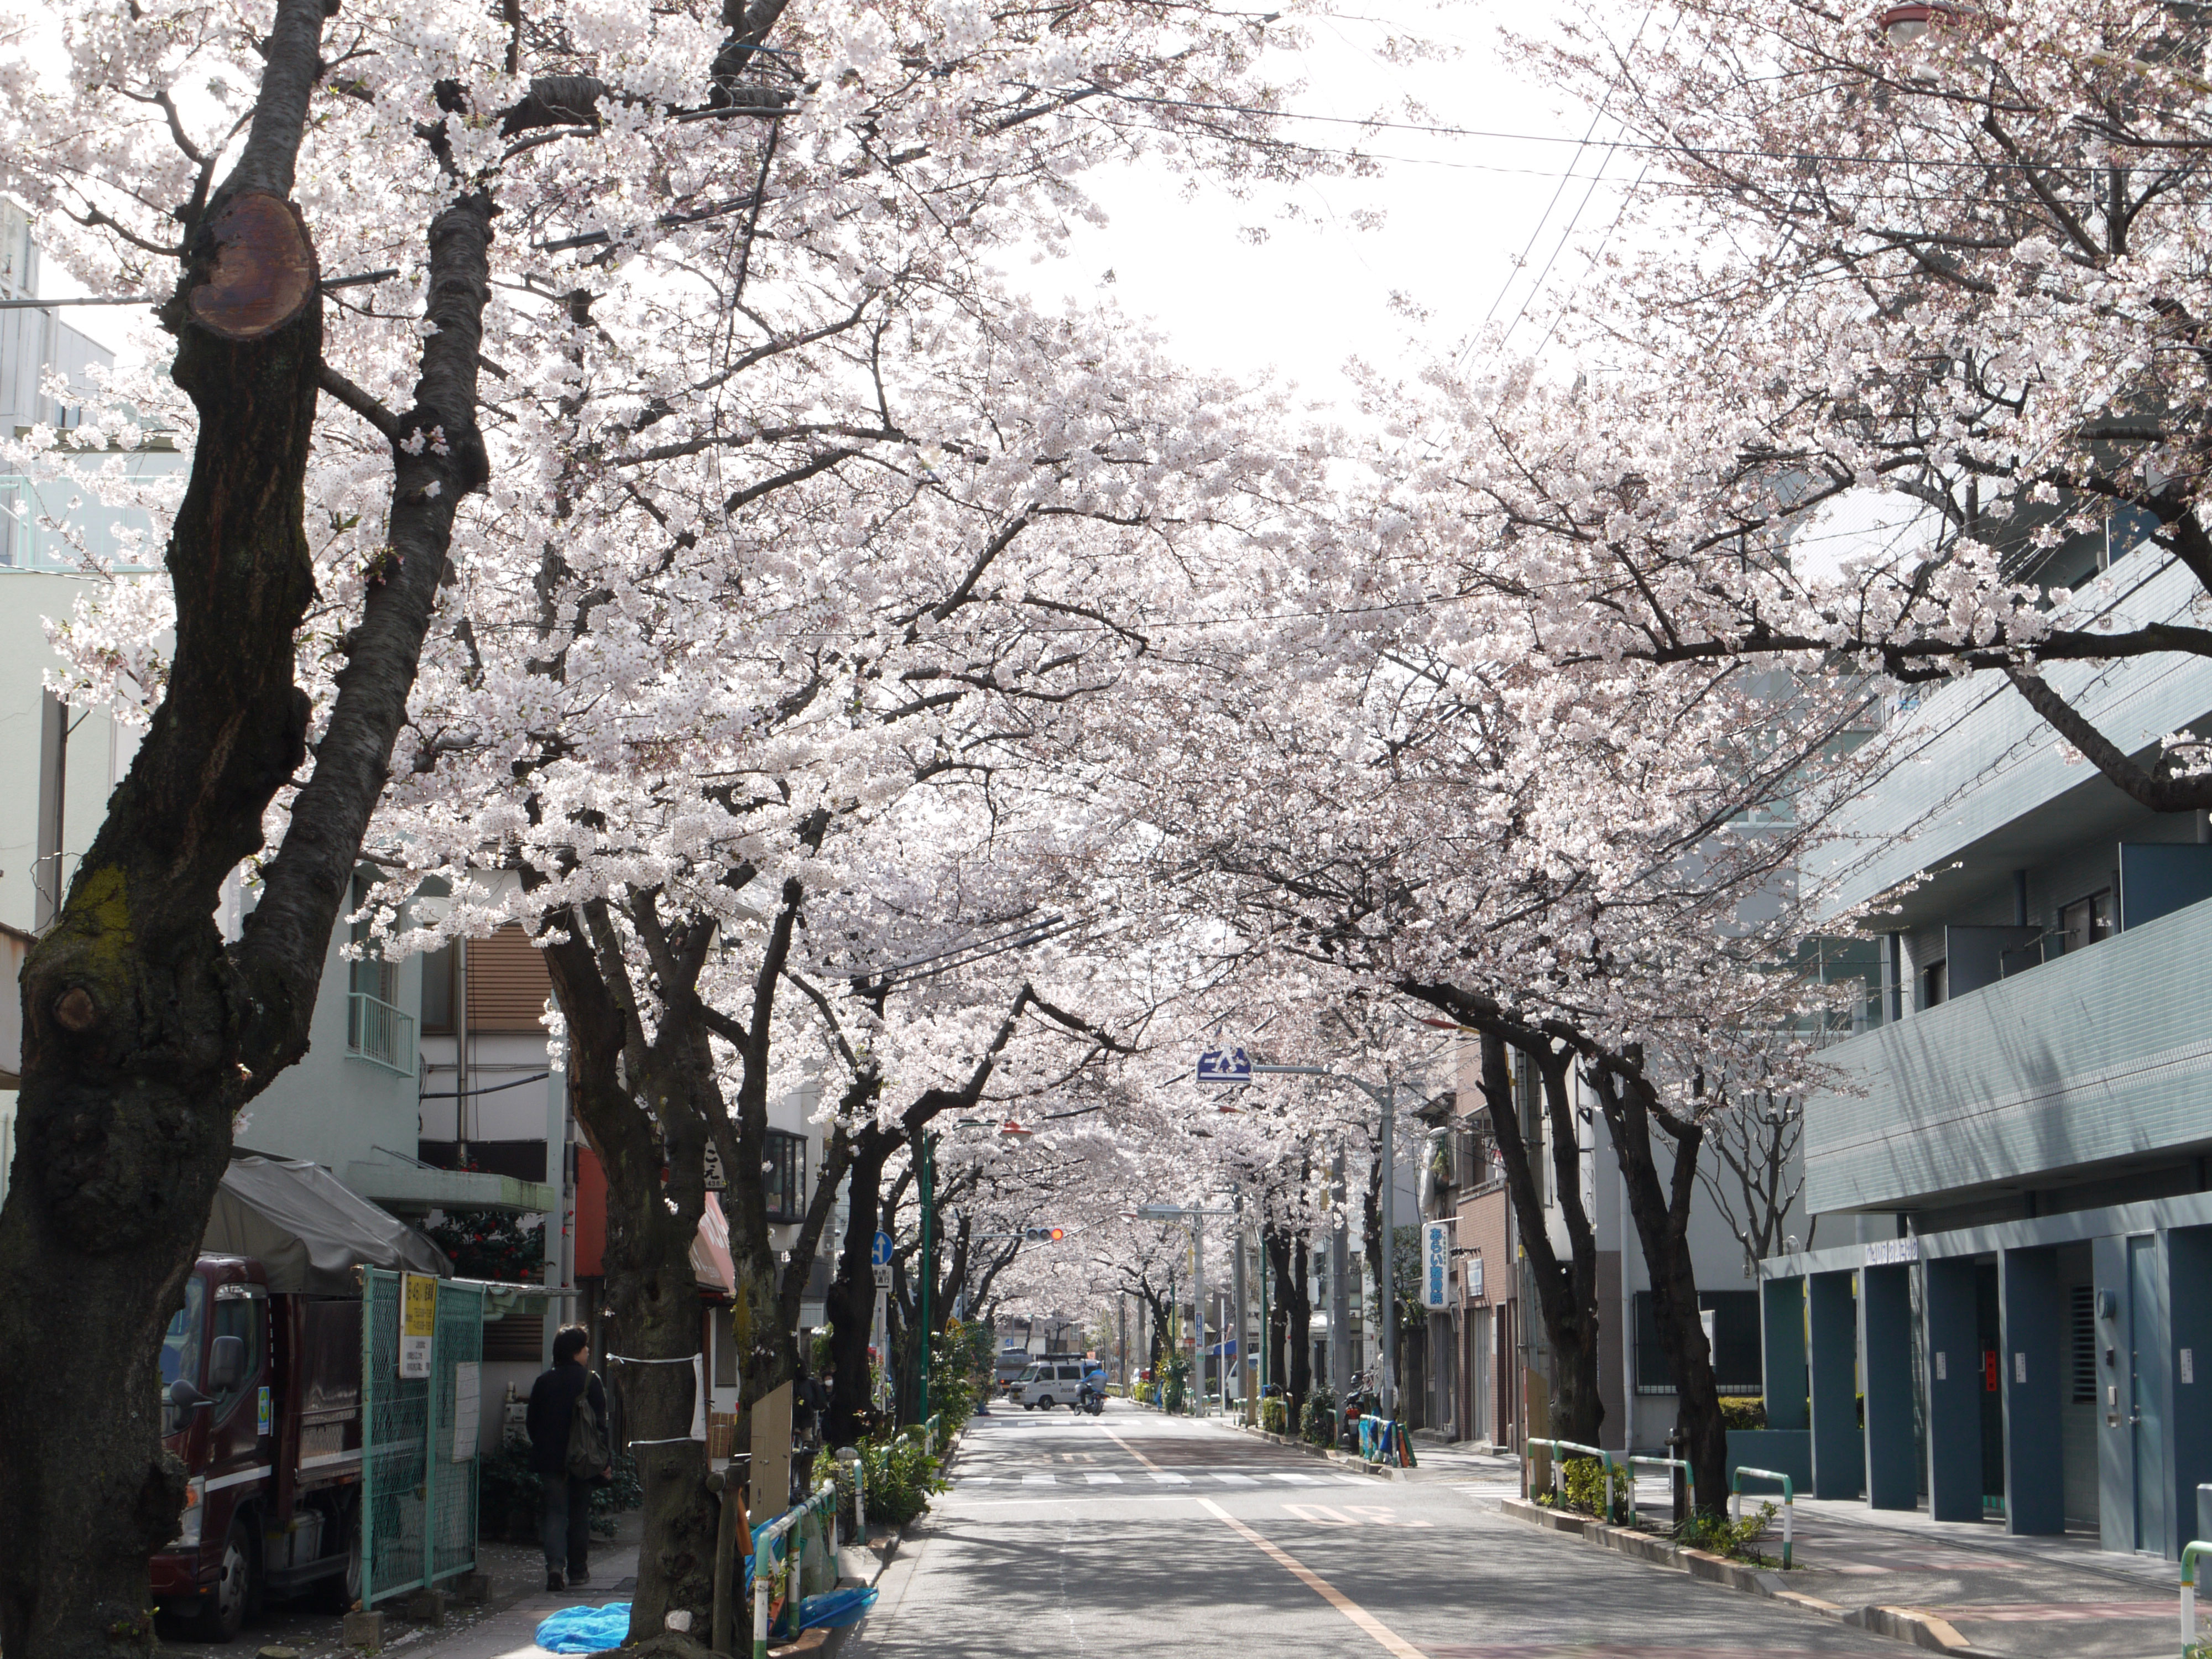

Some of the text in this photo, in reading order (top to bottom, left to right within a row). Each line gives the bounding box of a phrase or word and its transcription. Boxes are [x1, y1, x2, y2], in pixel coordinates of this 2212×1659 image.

[1430, 1228, 1443, 1305] あらい整骨院
